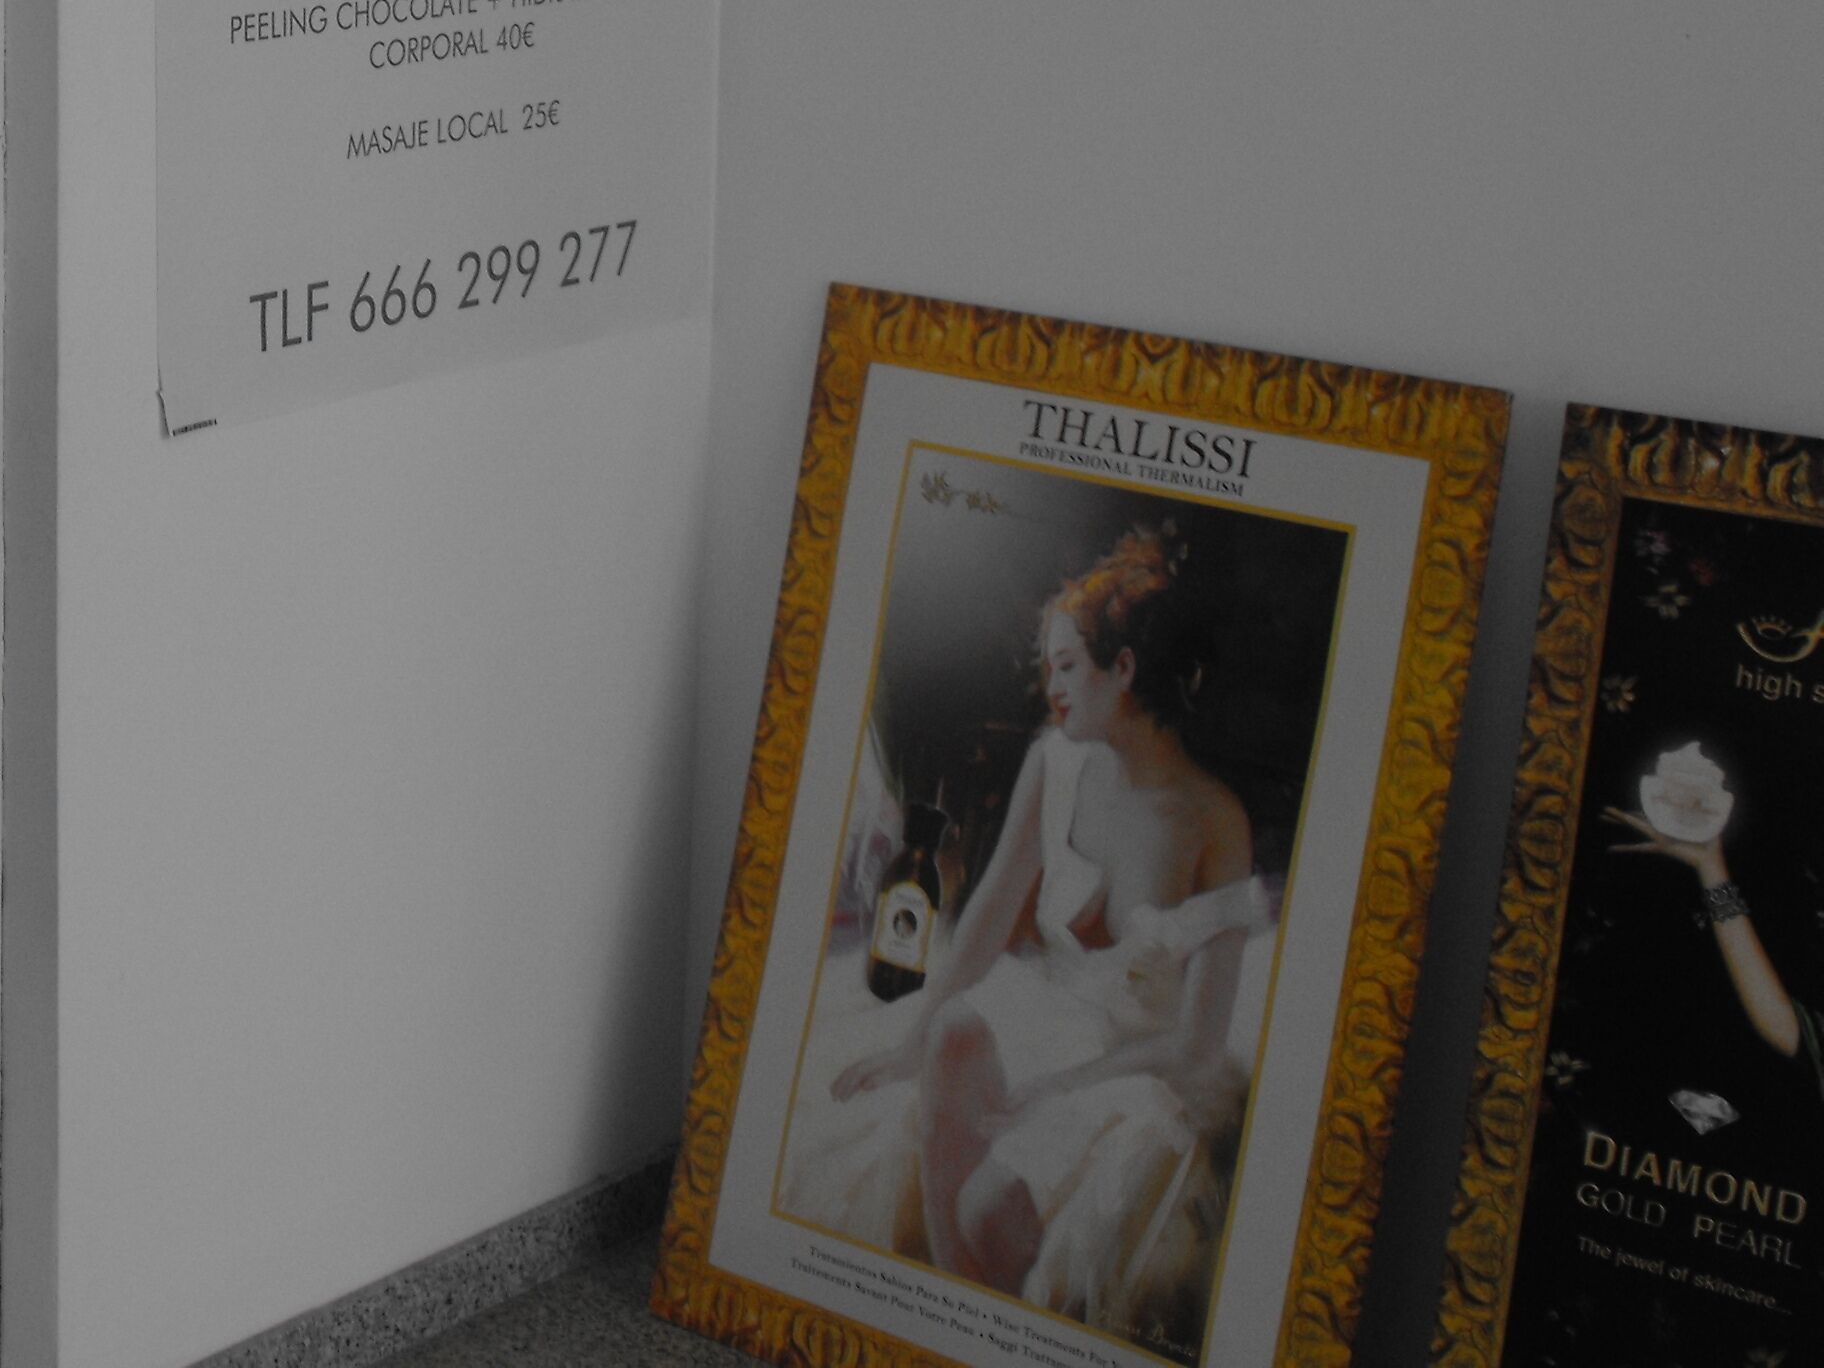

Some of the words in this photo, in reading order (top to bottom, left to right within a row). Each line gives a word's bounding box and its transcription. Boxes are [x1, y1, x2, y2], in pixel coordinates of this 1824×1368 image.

[230, 5, 327, 44] PEELING
[369, 28, 489, 69] CORPORAL
[496, 22, 535, 50] 40€
[346, 120, 428, 159] MASAJE
[437, 109, 508, 145] LOCAL
[522, 100, 560, 131] 25€
[249, 280, 329, 352] TLF
[350, 259, 437, 332] 666
[458, 239, 541, 309] 299
[559, 219, 638, 288] 277
[1023, 398, 1258, 479] THALISSI
[1019, 441, 1133, 477] PROFESSIONAL
[1137, 461, 1245, 498] THERMALISM
[1736, 663, 1803, 701] high
[1583, 1130, 1808, 1225] DIAMOND
[1576, 1182, 1667, 1227] GOLD
[1693, 1214, 1803, 1269] PEARL
[1578, 1234, 1612, 1259] The
[1614, 1247, 1665, 1275] jewel
[1668, 1264, 1690, 1282] of
[1023, 1325, 1086, 1358] Treatments
